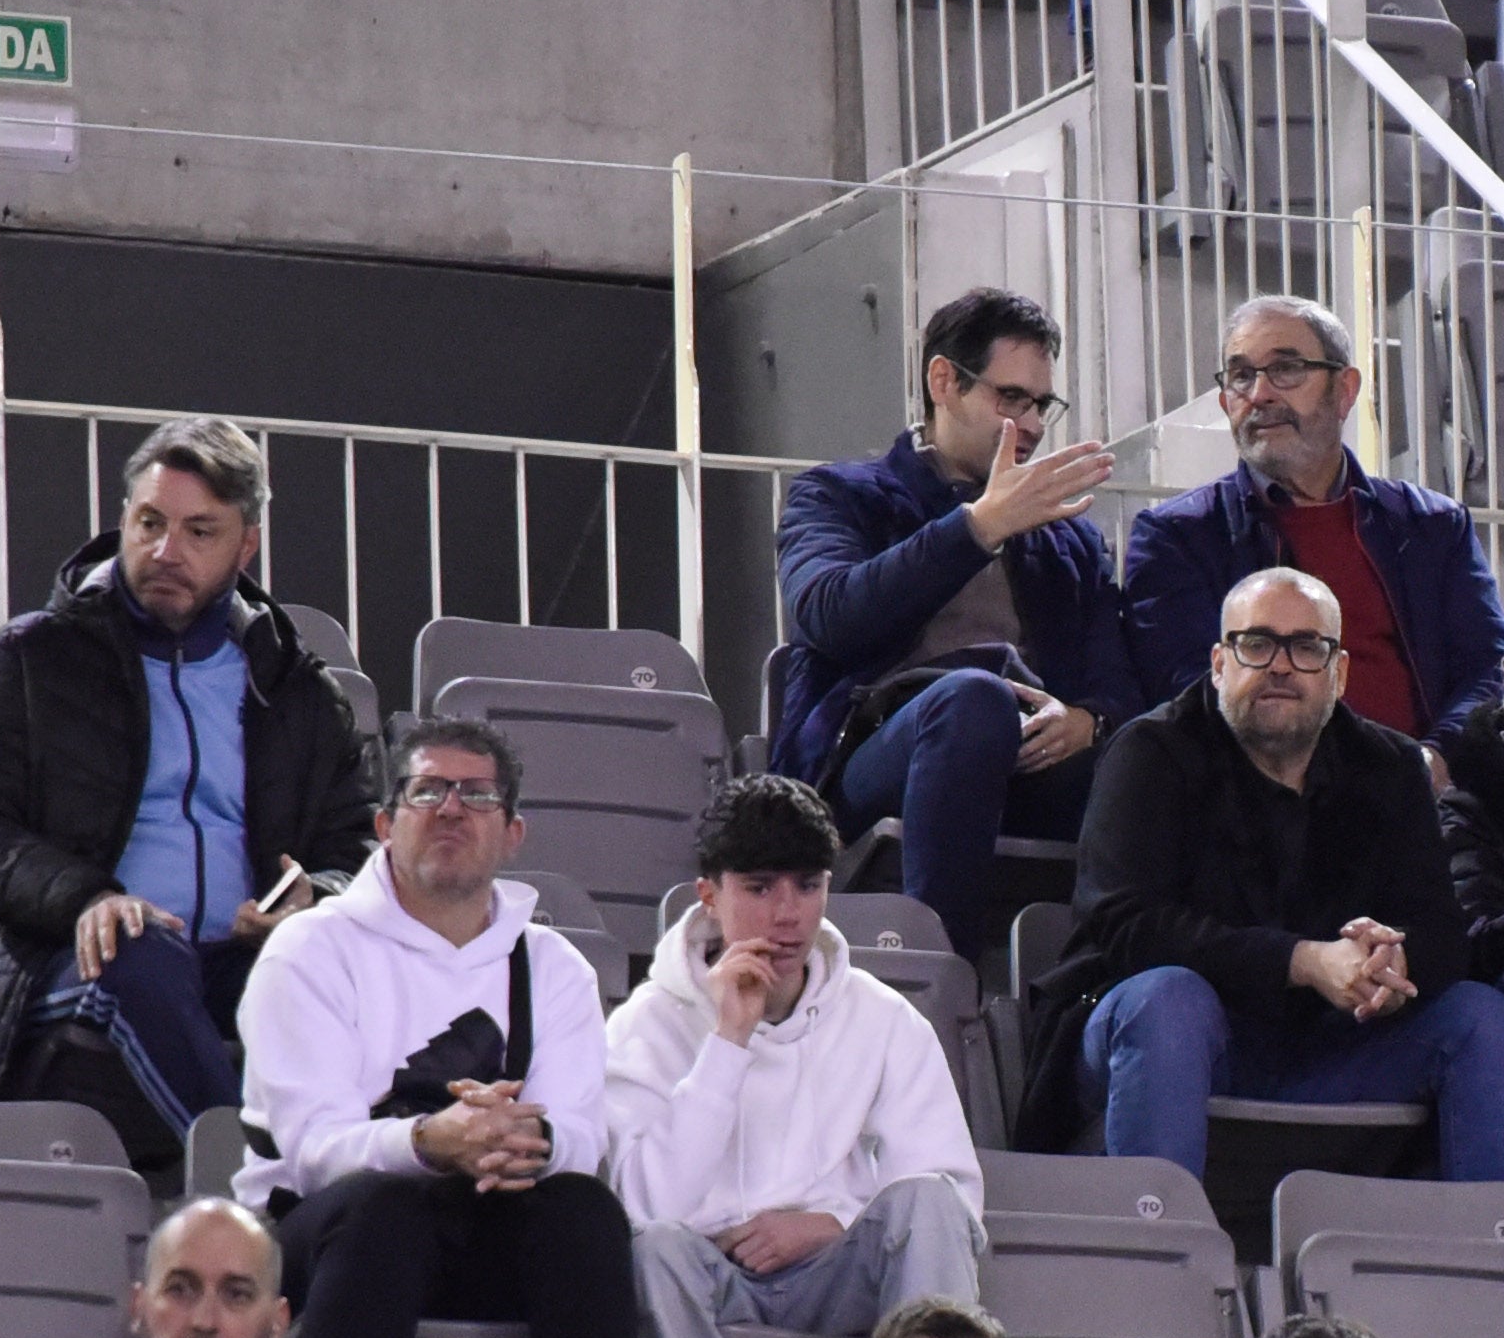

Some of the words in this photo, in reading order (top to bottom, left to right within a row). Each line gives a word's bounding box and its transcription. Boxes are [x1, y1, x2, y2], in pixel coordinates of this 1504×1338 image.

[636, 673, 652, 682] 70
[882, 939, 898, 948] 70
[1141, 1202, 1159, 1212] 70
